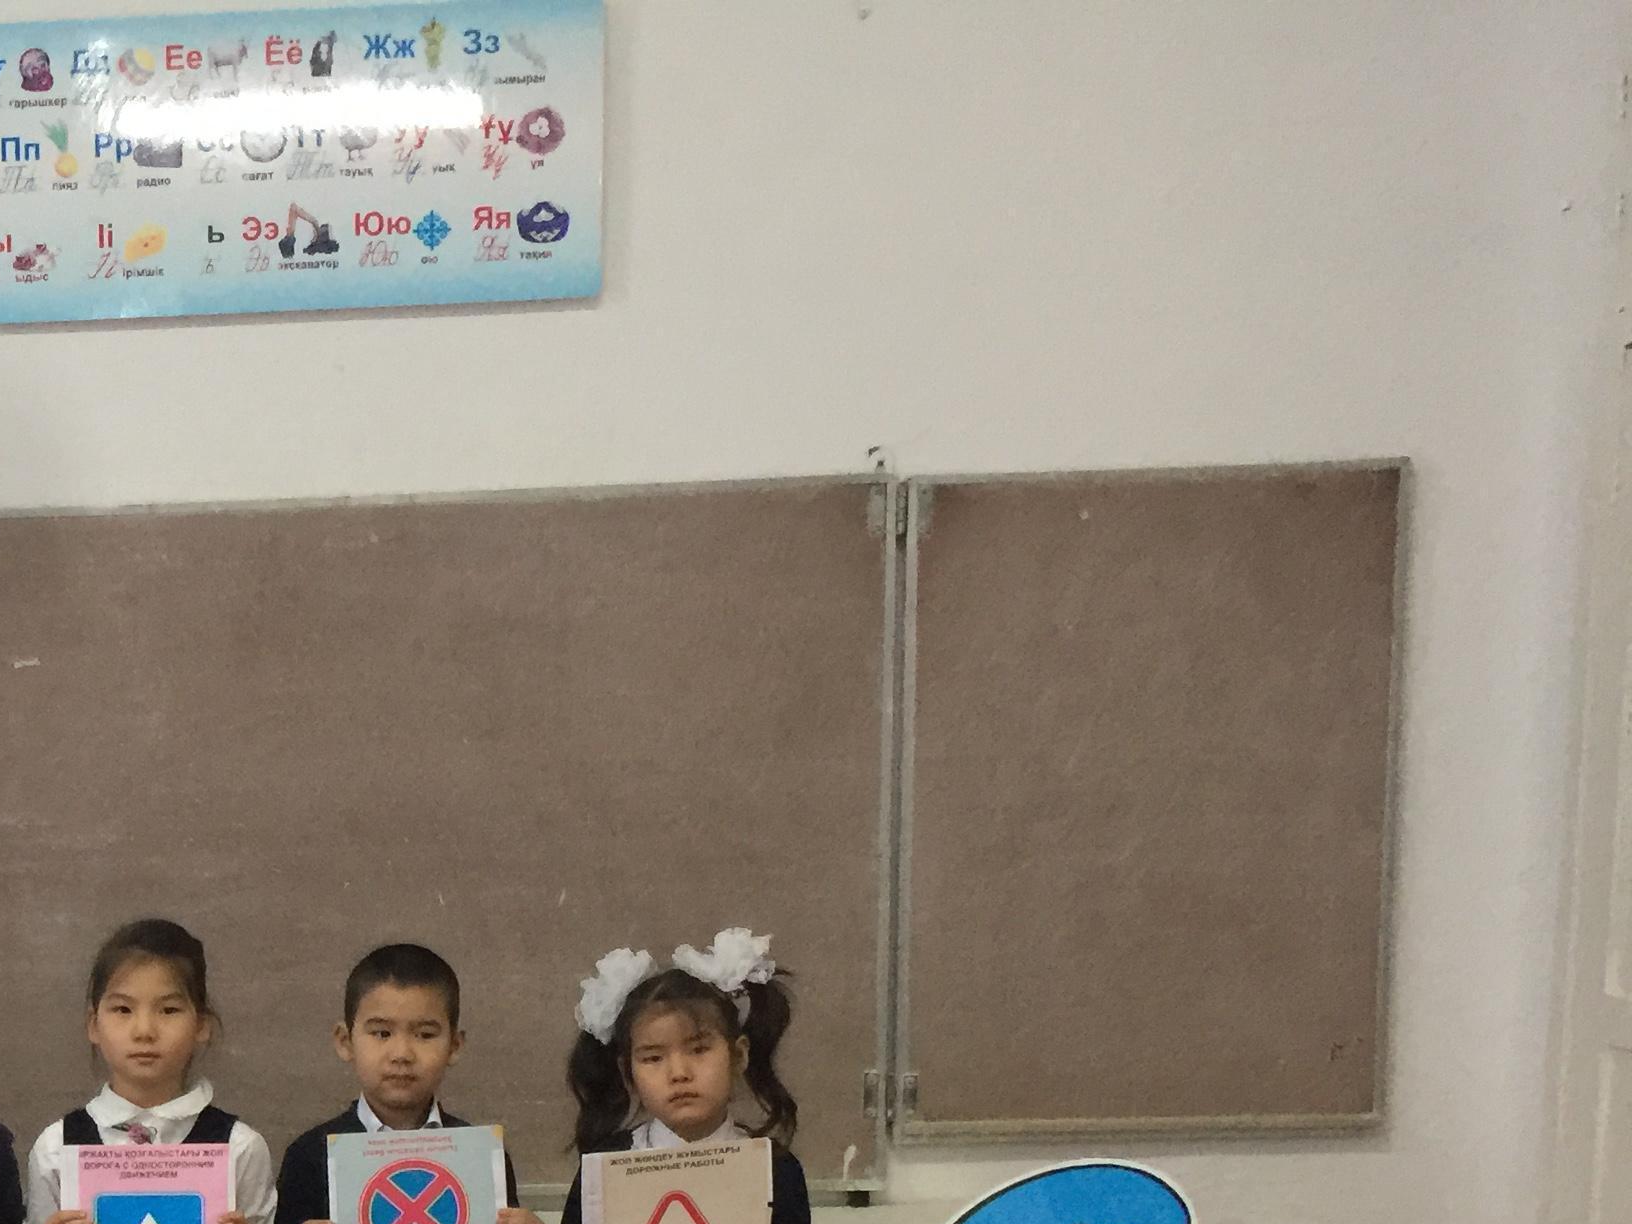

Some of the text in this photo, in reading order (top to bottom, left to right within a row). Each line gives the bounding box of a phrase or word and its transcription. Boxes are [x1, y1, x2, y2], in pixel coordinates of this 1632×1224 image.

[266, 35, 303, 66] Ёё
[363, 33, 416, 60] Жж
[463, 29, 500, 55] Зз
[166, 44, 202, 70] Ее
[1, 137, 41, 162] Пп
[94, 133, 132, 163] Рр
[242, 216, 278, 242] Ээ
[355, 212, 411, 237] Юю
[473, 206, 510, 231] Яя
[84, 1161, 121, 1170] ДОРОГА
